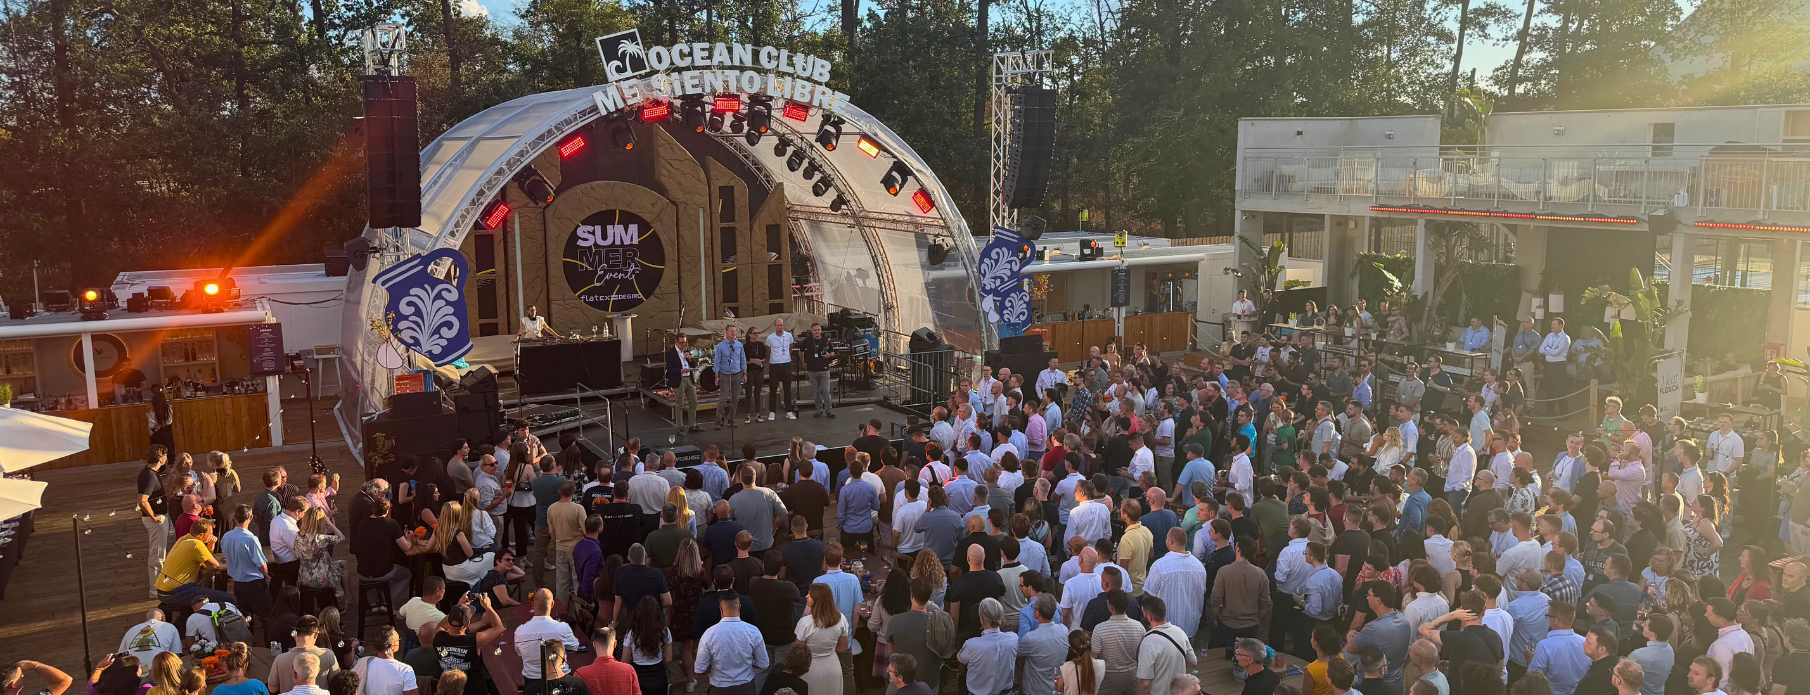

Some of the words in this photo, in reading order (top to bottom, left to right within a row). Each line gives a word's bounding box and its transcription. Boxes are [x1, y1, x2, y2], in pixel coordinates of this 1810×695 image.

[648, 42, 753, 70] OCEAN
[758, 45, 832, 83] CLUB
[592, 78, 644, 116] ME
[654, 69, 761, 97] SIENTO
[767, 73, 851, 115] LIBRE
[576, 224, 638, 247] SUM
[577, 247, 641, 272] MER
[594, 263, 636, 287] Event
